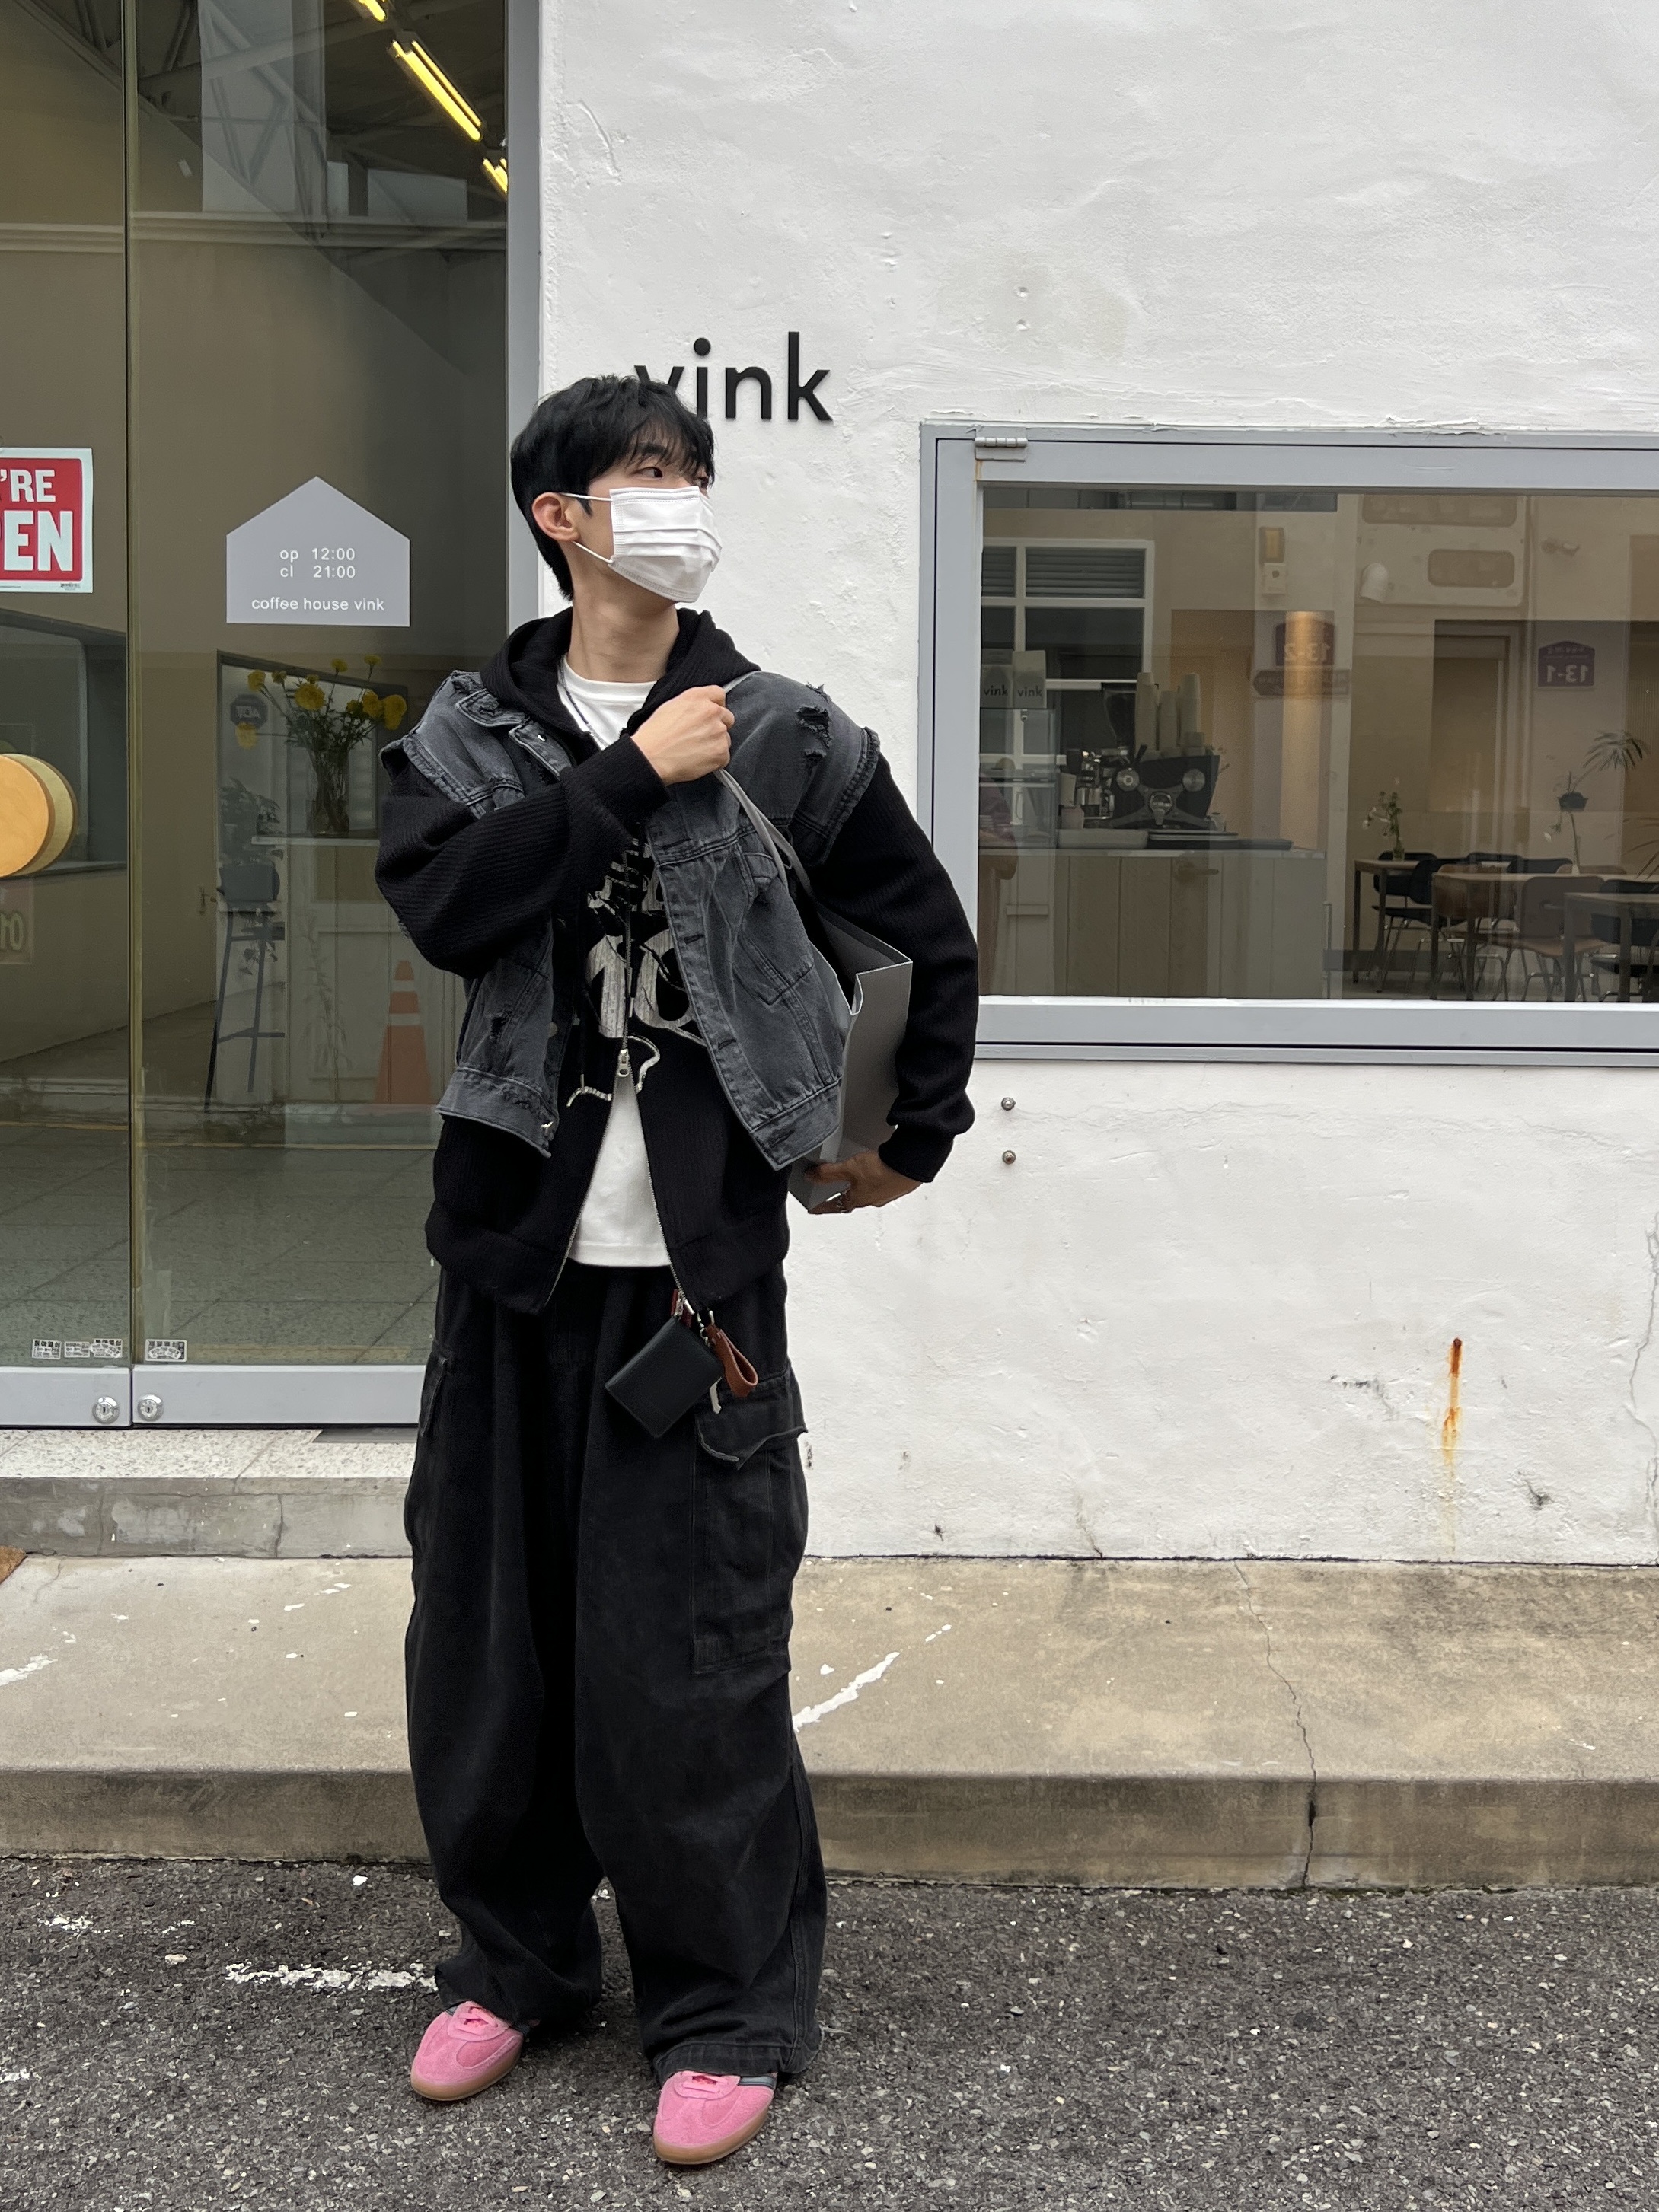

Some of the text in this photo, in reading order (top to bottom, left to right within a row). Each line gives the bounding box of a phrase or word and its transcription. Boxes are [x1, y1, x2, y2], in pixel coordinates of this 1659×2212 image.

[279, 547, 356, 563] op 12:00
[280, 565, 356, 578] cl 21:00
[251, 597, 384, 610] coffee house vink
[984, 684, 1009, 696] vink
[1017, 685, 1042, 697] vink
